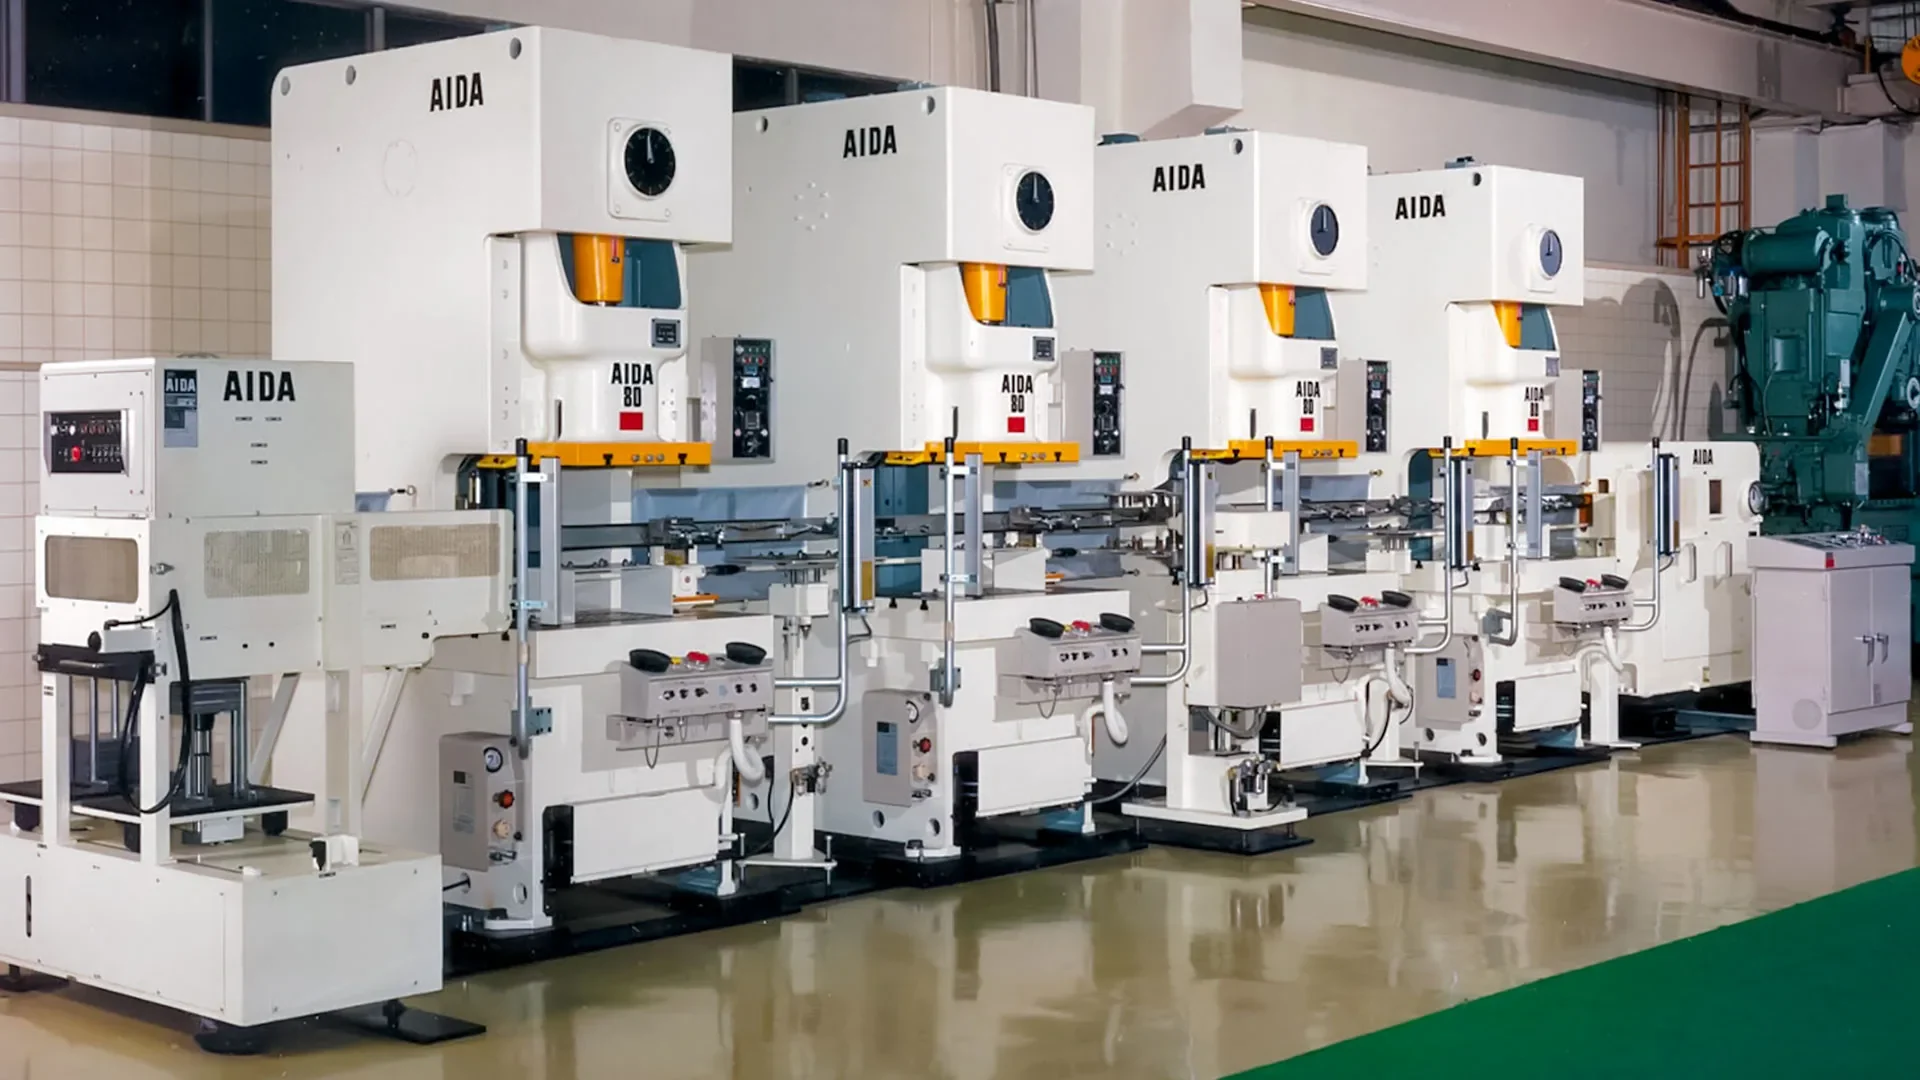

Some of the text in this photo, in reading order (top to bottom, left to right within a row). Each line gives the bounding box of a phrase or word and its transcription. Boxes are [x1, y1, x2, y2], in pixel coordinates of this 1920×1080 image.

[430, 72, 484, 112] AIDA
[843, 125, 897, 158] AIDA
[1153, 164, 1206, 192] AIDA
[1396, 195, 1446, 220] AIDA
[611, 363, 654, 385] AIDA
[1001, 374, 1033, 393] AIDA
[165, 378, 196, 392] AIDA
[224, 371, 296, 401] AIDA
[1295, 381, 1321, 398] AIDA
[1524, 386, 1544, 401] AIDA
[623, 386, 642, 407] 80
[1011, 395, 1025, 412] 80
[1692, 449, 1713, 464] AIDA
